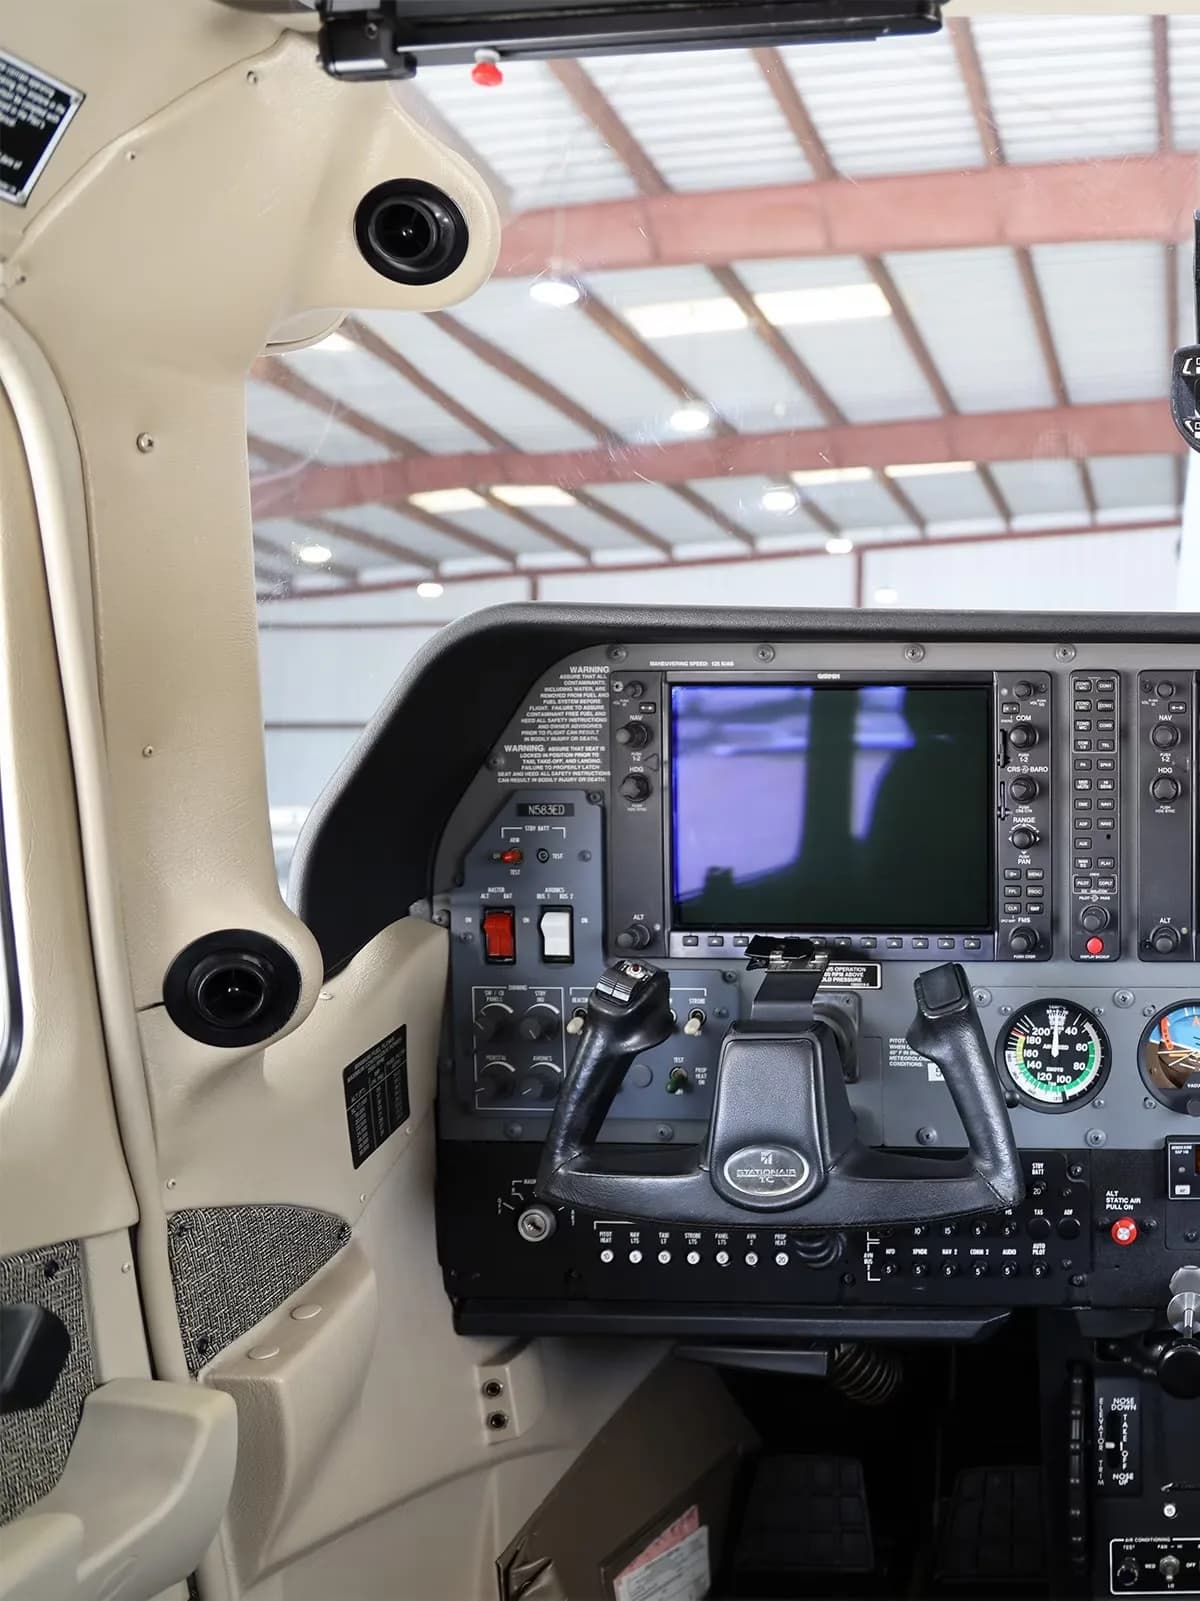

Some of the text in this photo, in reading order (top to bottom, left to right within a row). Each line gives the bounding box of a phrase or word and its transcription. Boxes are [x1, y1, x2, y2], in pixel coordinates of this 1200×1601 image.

[528, 805, 565, 815] N583ED
[1032, 1028, 1050, 1036] 200
[1065, 1027, 1078, 1035] 40
[1027, 1061, 1042, 1069] 140
[1073, 1062, 1086, 1070] 80
[1037, 1072, 1052, 1080] 120
[1057, 1075, 1072, 1083] 100
[736, 1168, 796, 1177] STATIONAIR
[914, 1227, 921, 1235] 10
[975, 1227, 981, 1235] 5
[916, 1266, 921, 1274] 5
[946, 1267, 951, 1275] 5
[975, 1267, 980, 1276] 5
[1005, 1267, 1010, 1275] 5
[1036, 1267, 1041, 1276] 5
[1112, 1472, 1134, 1480] NOSE
